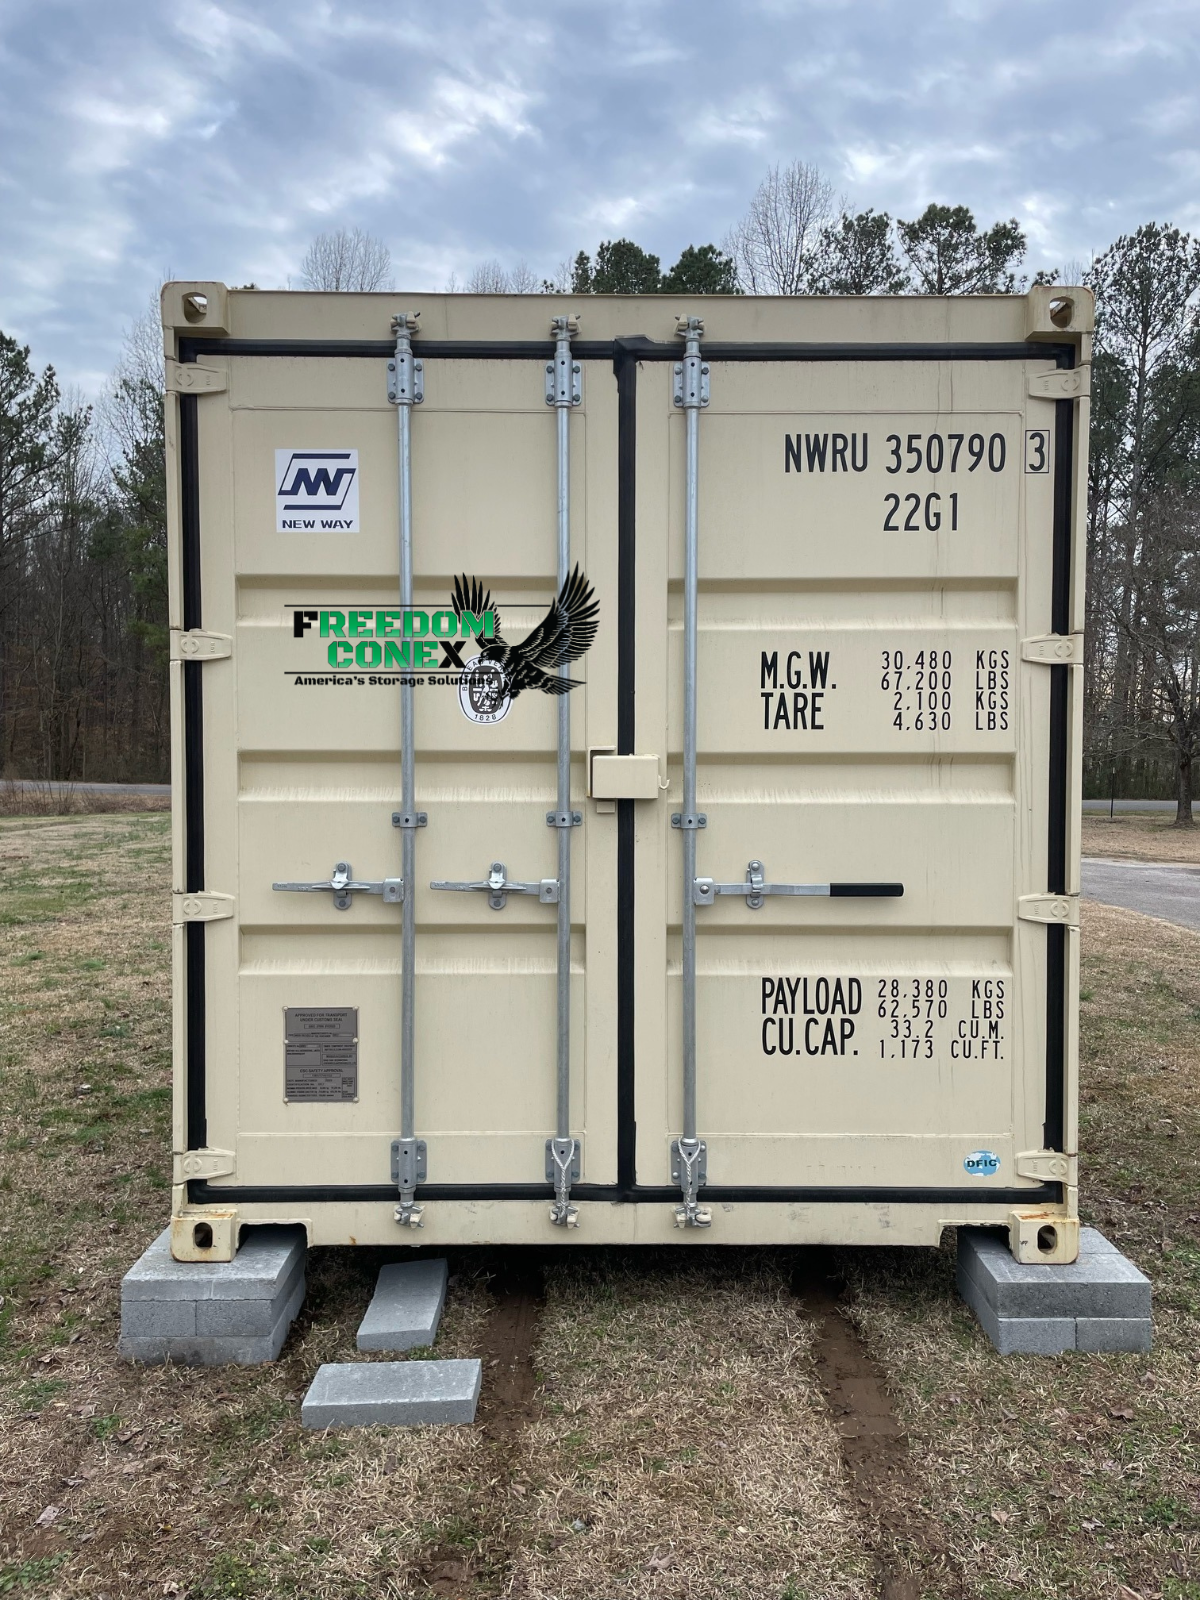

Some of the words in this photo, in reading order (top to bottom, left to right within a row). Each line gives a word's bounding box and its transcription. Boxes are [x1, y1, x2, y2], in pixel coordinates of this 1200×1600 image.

[784, 433, 868, 473] NWRU
[885, 432, 1006, 474] 350790
[1029, 432, 1046, 472] 3
[282, 519, 315, 529] NEW
[321, 519, 353, 529] WAY
[883, 492, 958, 531] 22G1
[760, 651, 837, 690] M.G.W.
[975, 650, 1010, 670] KGS
[975, 671, 1010, 690] LBS
[760, 692, 825, 730] TARE
[975, 691, 1010, 711] KGS
[975, 711, 1010, 731] LBS
[761, 977, 862, 1015] PAYLOAD
[971, 979, 1005, 999] KGS
[971, 999, 1005, 1019] LBS
[761, 1017, 859, 1056] CU.CAP.
[890, 1019, 934, 1039] 33.2
[958, 1020, 1004, 1040] CU.M.
[951, 1040, 1004, 1060] CU.FT.
[967, 1159, 997, 1168] DFIC
